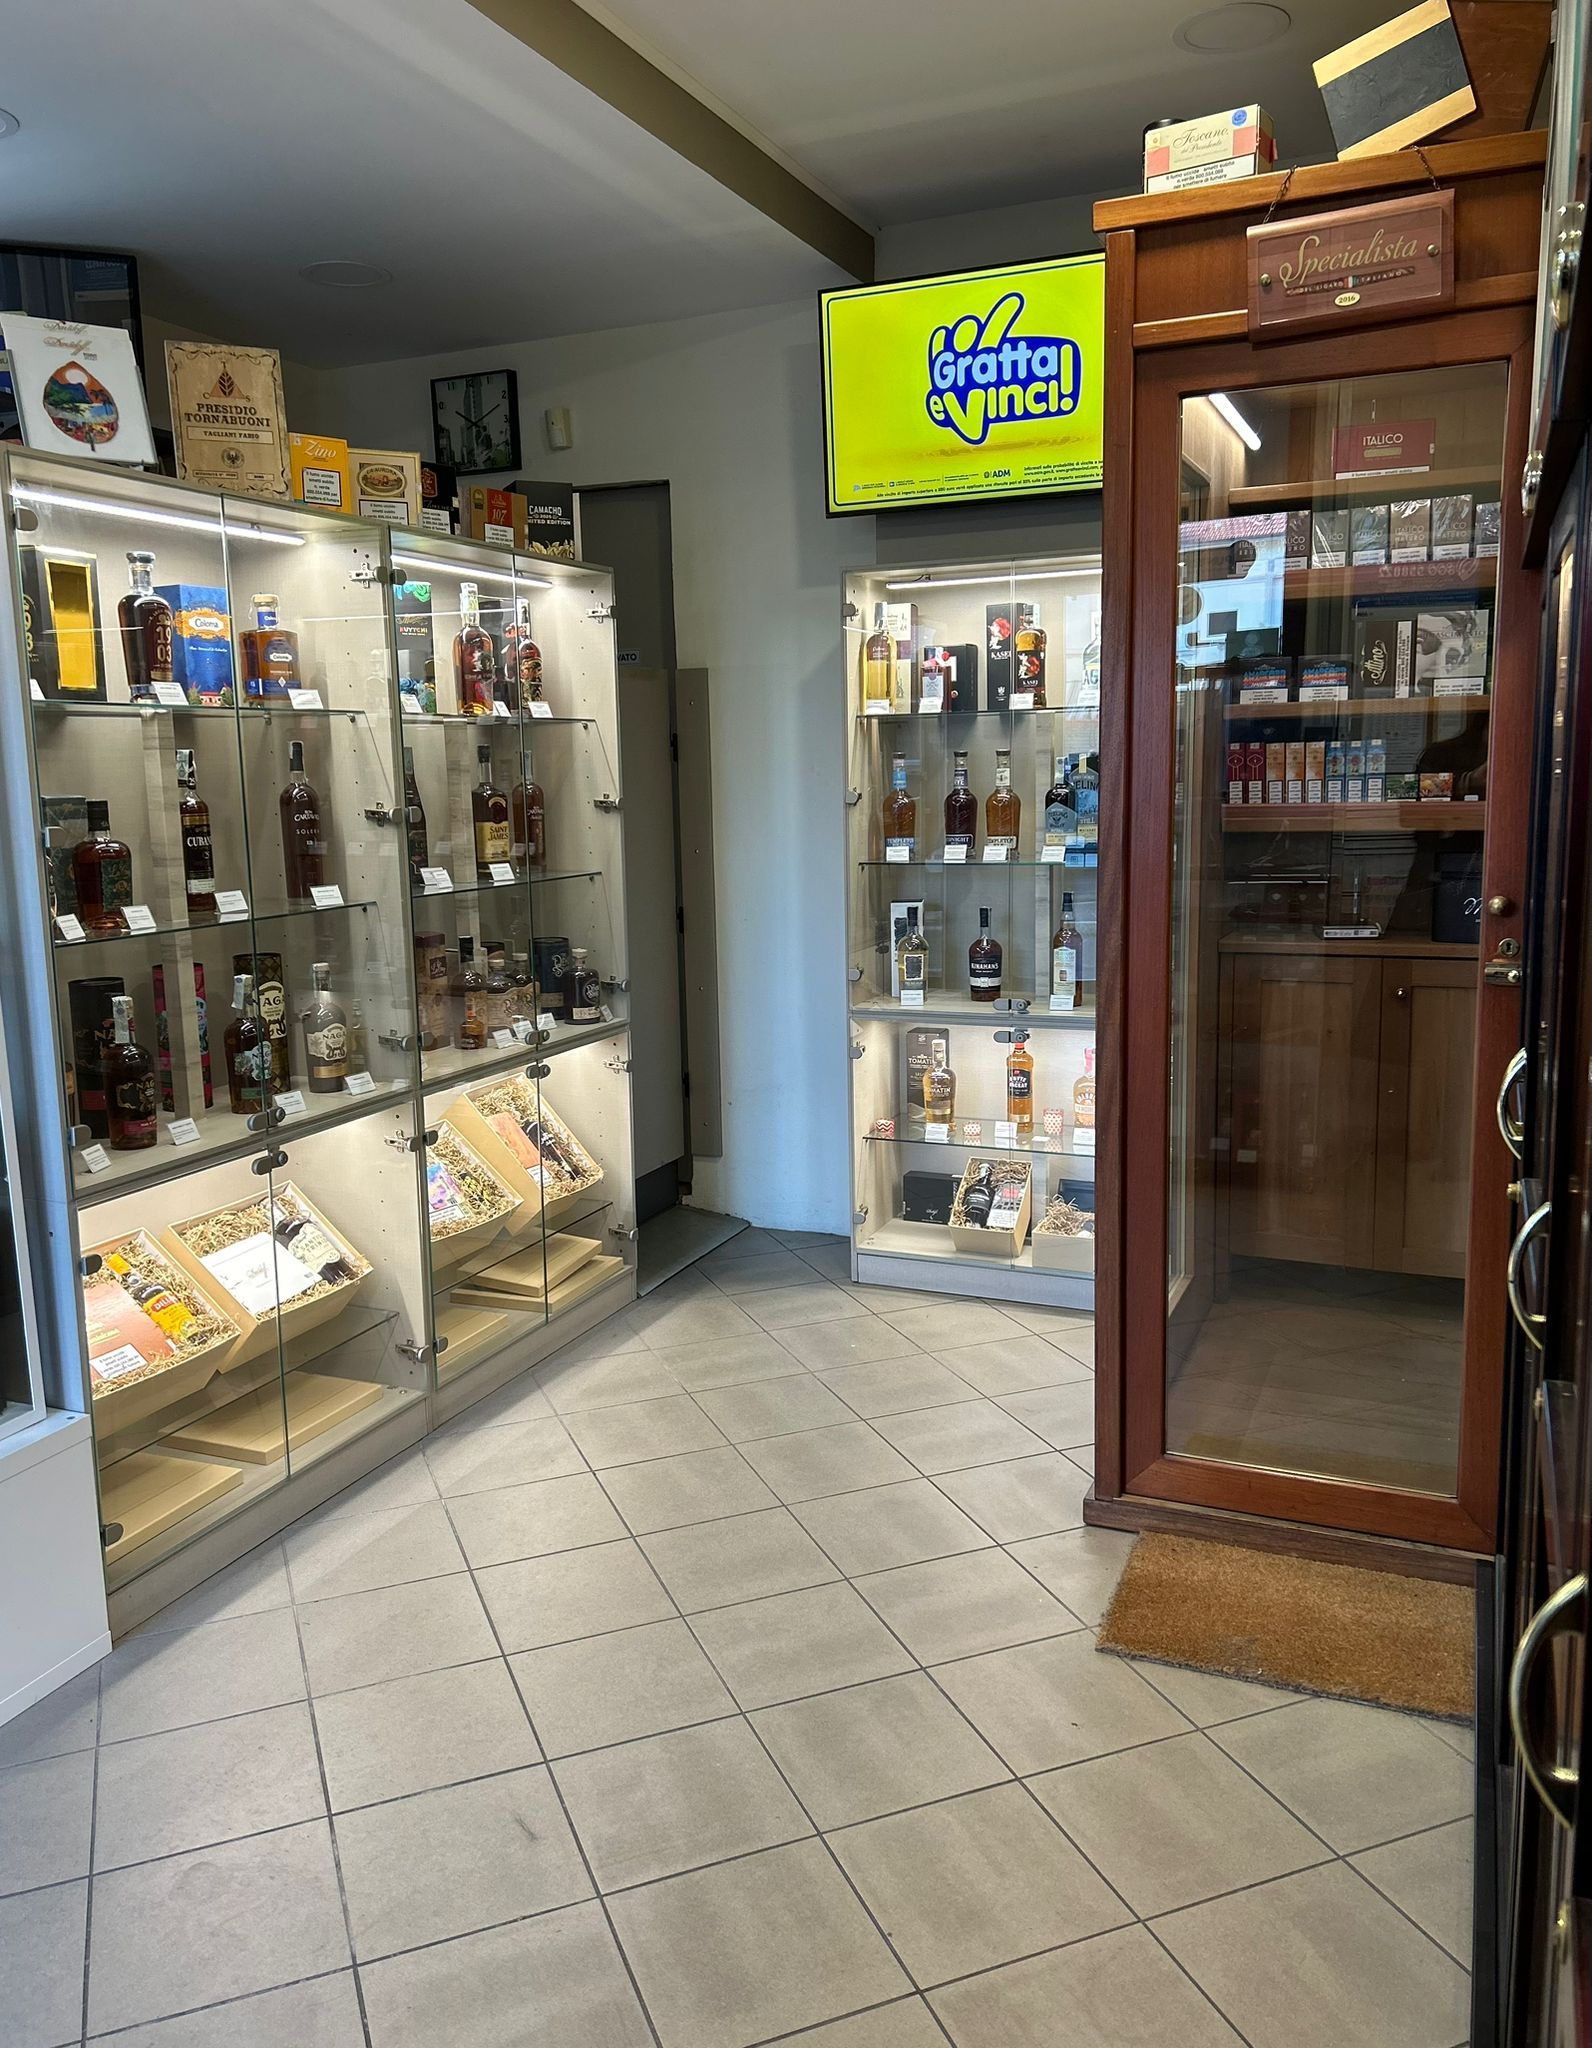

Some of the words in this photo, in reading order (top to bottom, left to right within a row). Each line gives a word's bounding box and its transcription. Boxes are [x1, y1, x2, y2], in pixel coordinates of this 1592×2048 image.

[1173, 128, 1228, 148] Toscano
[1279, 228, 1418, 288] Specialista
[1338, 295, 1356, 304] 2016
[933, 341, 1058, 389] Gratta
[196, 403, 257, 416] PRESIDIO
[929, 394, 946, 421] e
[184, 413, 271, 427] TORNABUONI
[1363, 433, 1403, 446] ITALICO
[305, 440, 337, 458] Zino
[992, 470, 1011, 478] ADM
[492, 509, 507, 522] 107
[529, 505, 562, 517] CAMACHO
[194, 618, 219, 629] Coloma
[617, 653, 637, 661] VATO
[488, 832, 508, 841] JAMES
